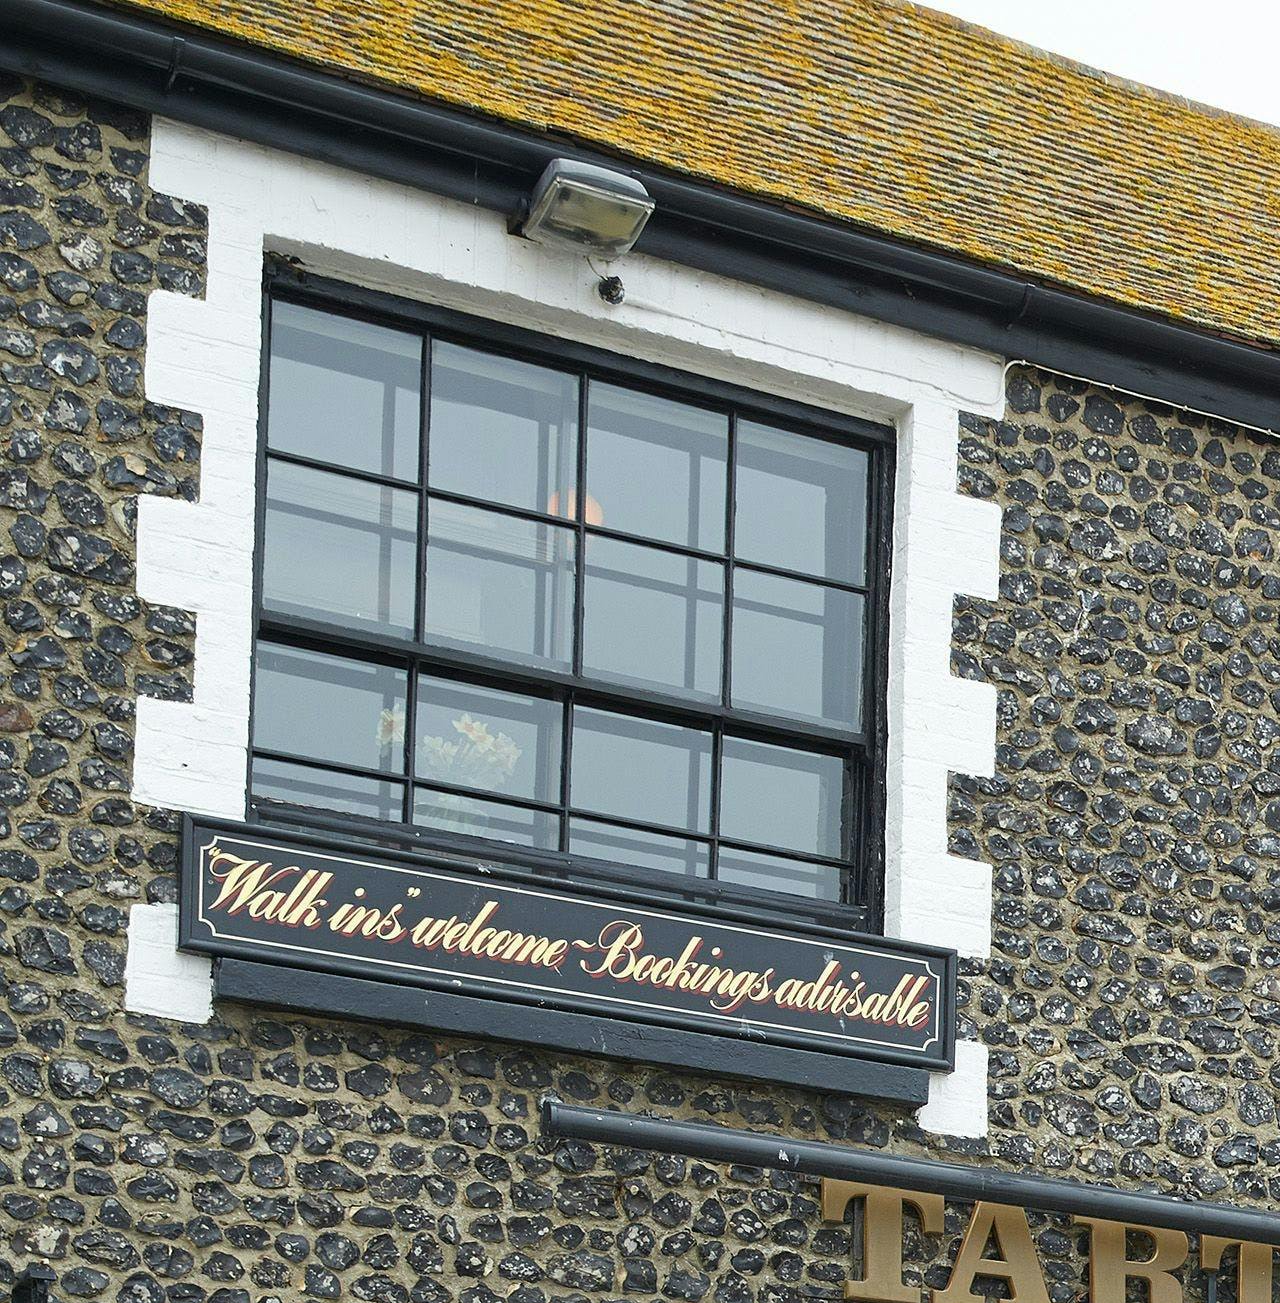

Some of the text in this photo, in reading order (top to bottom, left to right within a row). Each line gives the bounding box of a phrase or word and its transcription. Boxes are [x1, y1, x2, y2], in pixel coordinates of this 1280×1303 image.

[412, 900, 568, 969] welcome
[580, 920, 773, 1010] Bookings
[773, 960, 930, 1028] advisable
